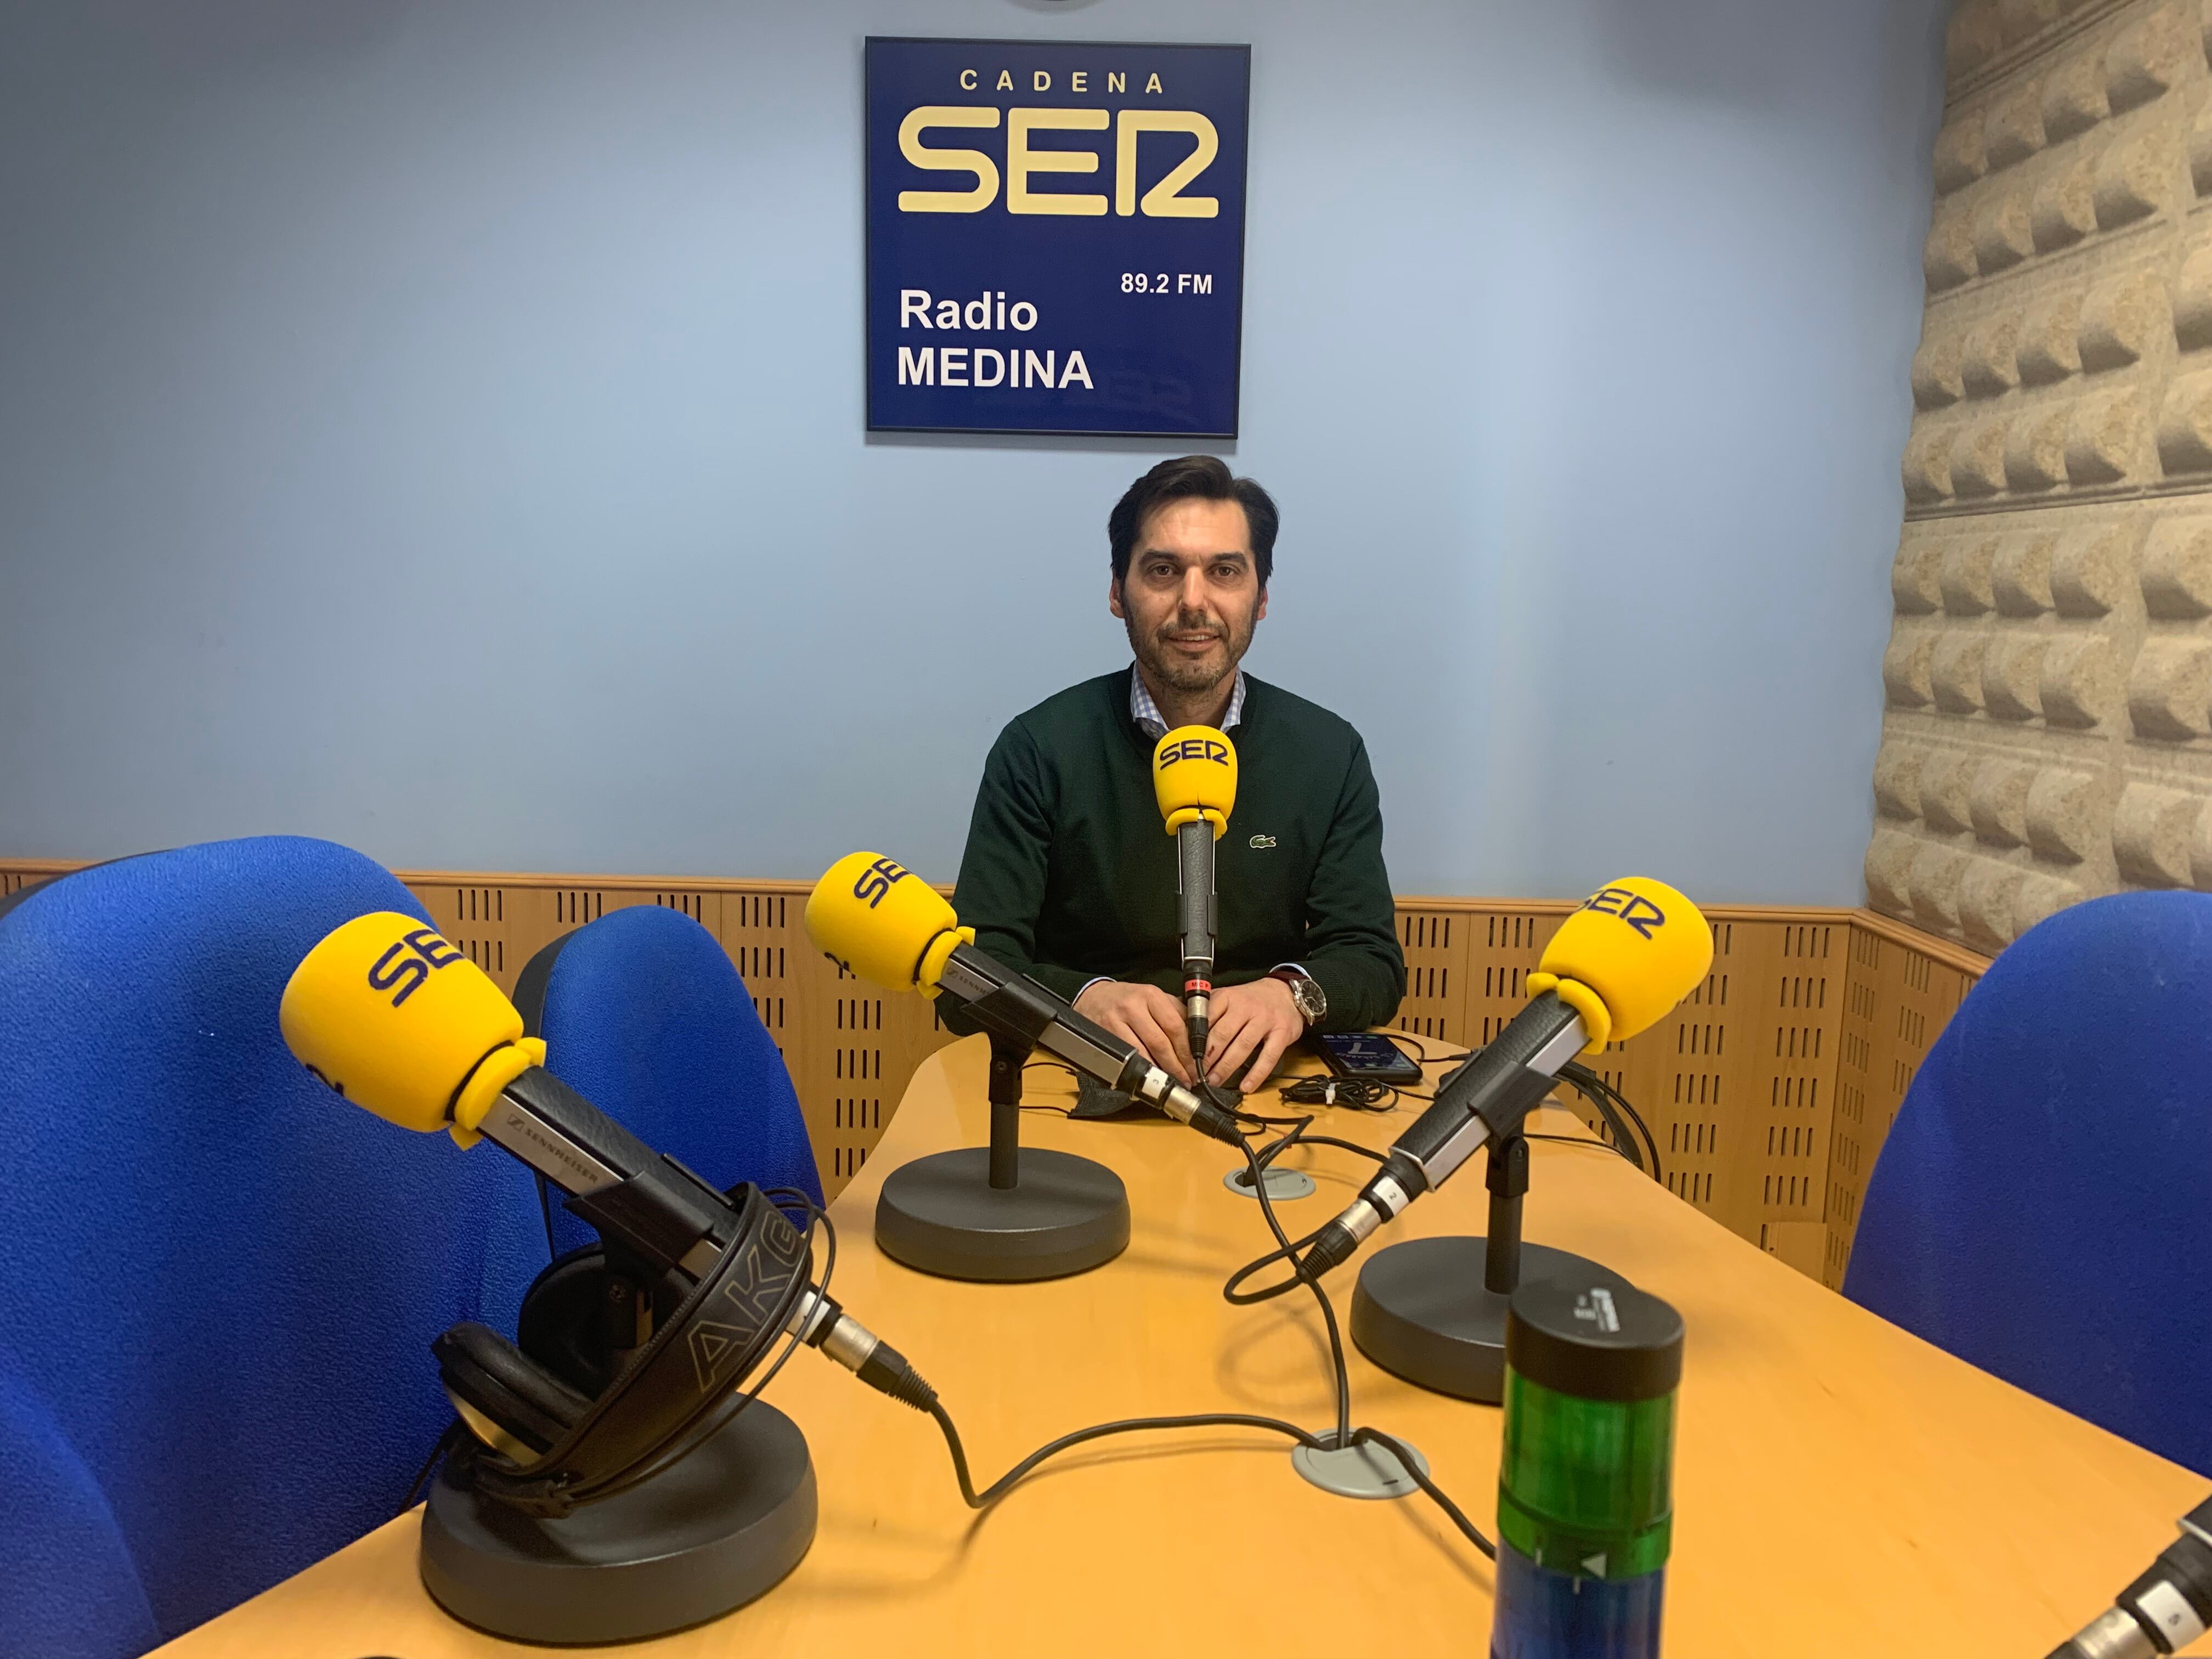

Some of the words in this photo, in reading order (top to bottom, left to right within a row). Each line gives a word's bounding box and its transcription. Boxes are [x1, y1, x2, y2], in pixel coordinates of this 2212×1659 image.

[960, 69, 1163, 94] CADENA
[898, 105, 1219, 218] SER
[1120, 273, 1170, 294] 89.2
[1177, 274, 1213, 295] FM
[900, 289, 1039, 331] Radio
[898, 346, 1094, 390] MEDINA
[1159, 739, 1229, 770] SER
[853, 858, 914, 909] SE
[368, 929, 466, 1008] SE
[523, 1128, 598, 1183] SENNHEISER
[687, 1210, 804, 1394] AKG
